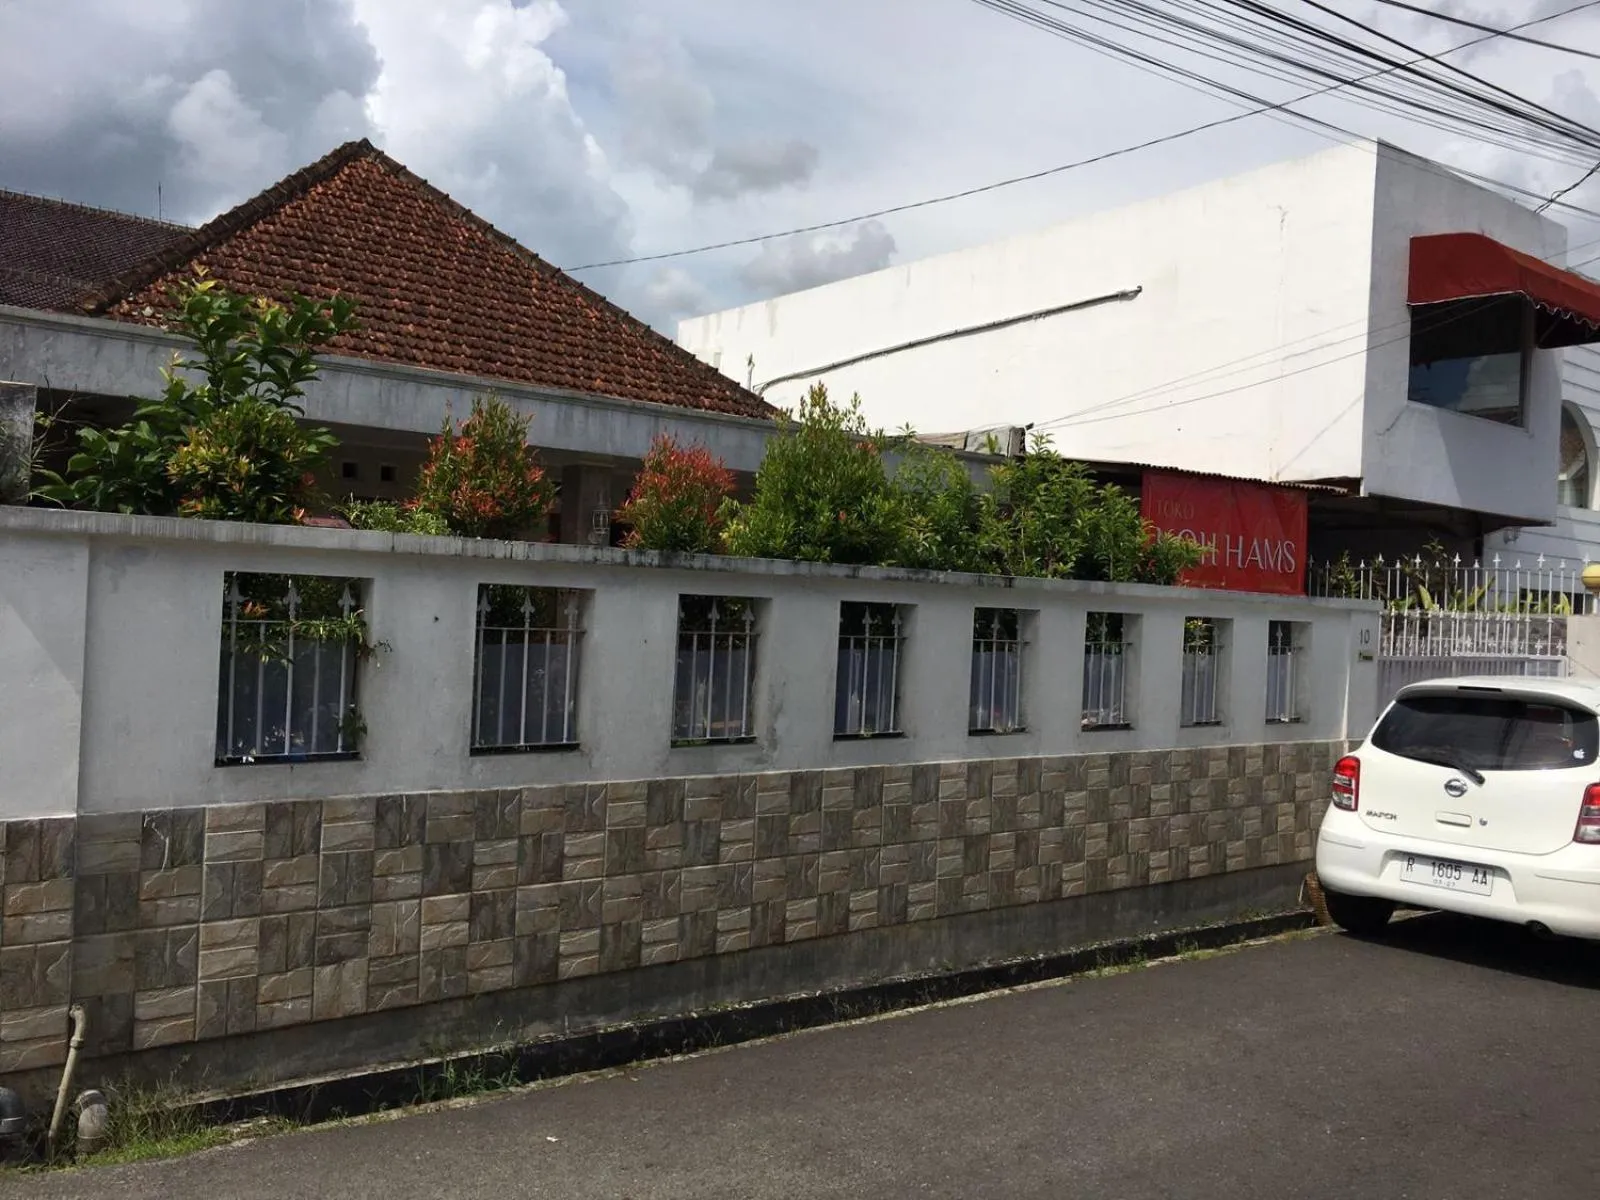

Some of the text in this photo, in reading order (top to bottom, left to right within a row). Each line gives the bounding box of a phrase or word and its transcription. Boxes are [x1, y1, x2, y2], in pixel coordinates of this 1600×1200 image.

[1157, 499, 1194, 520] TOKO
[1226, 534, 1296, 573] HAMS
[1359, 629, 1371, 644] 10
[1406, 856, 1488, 886] R 1605 AA
